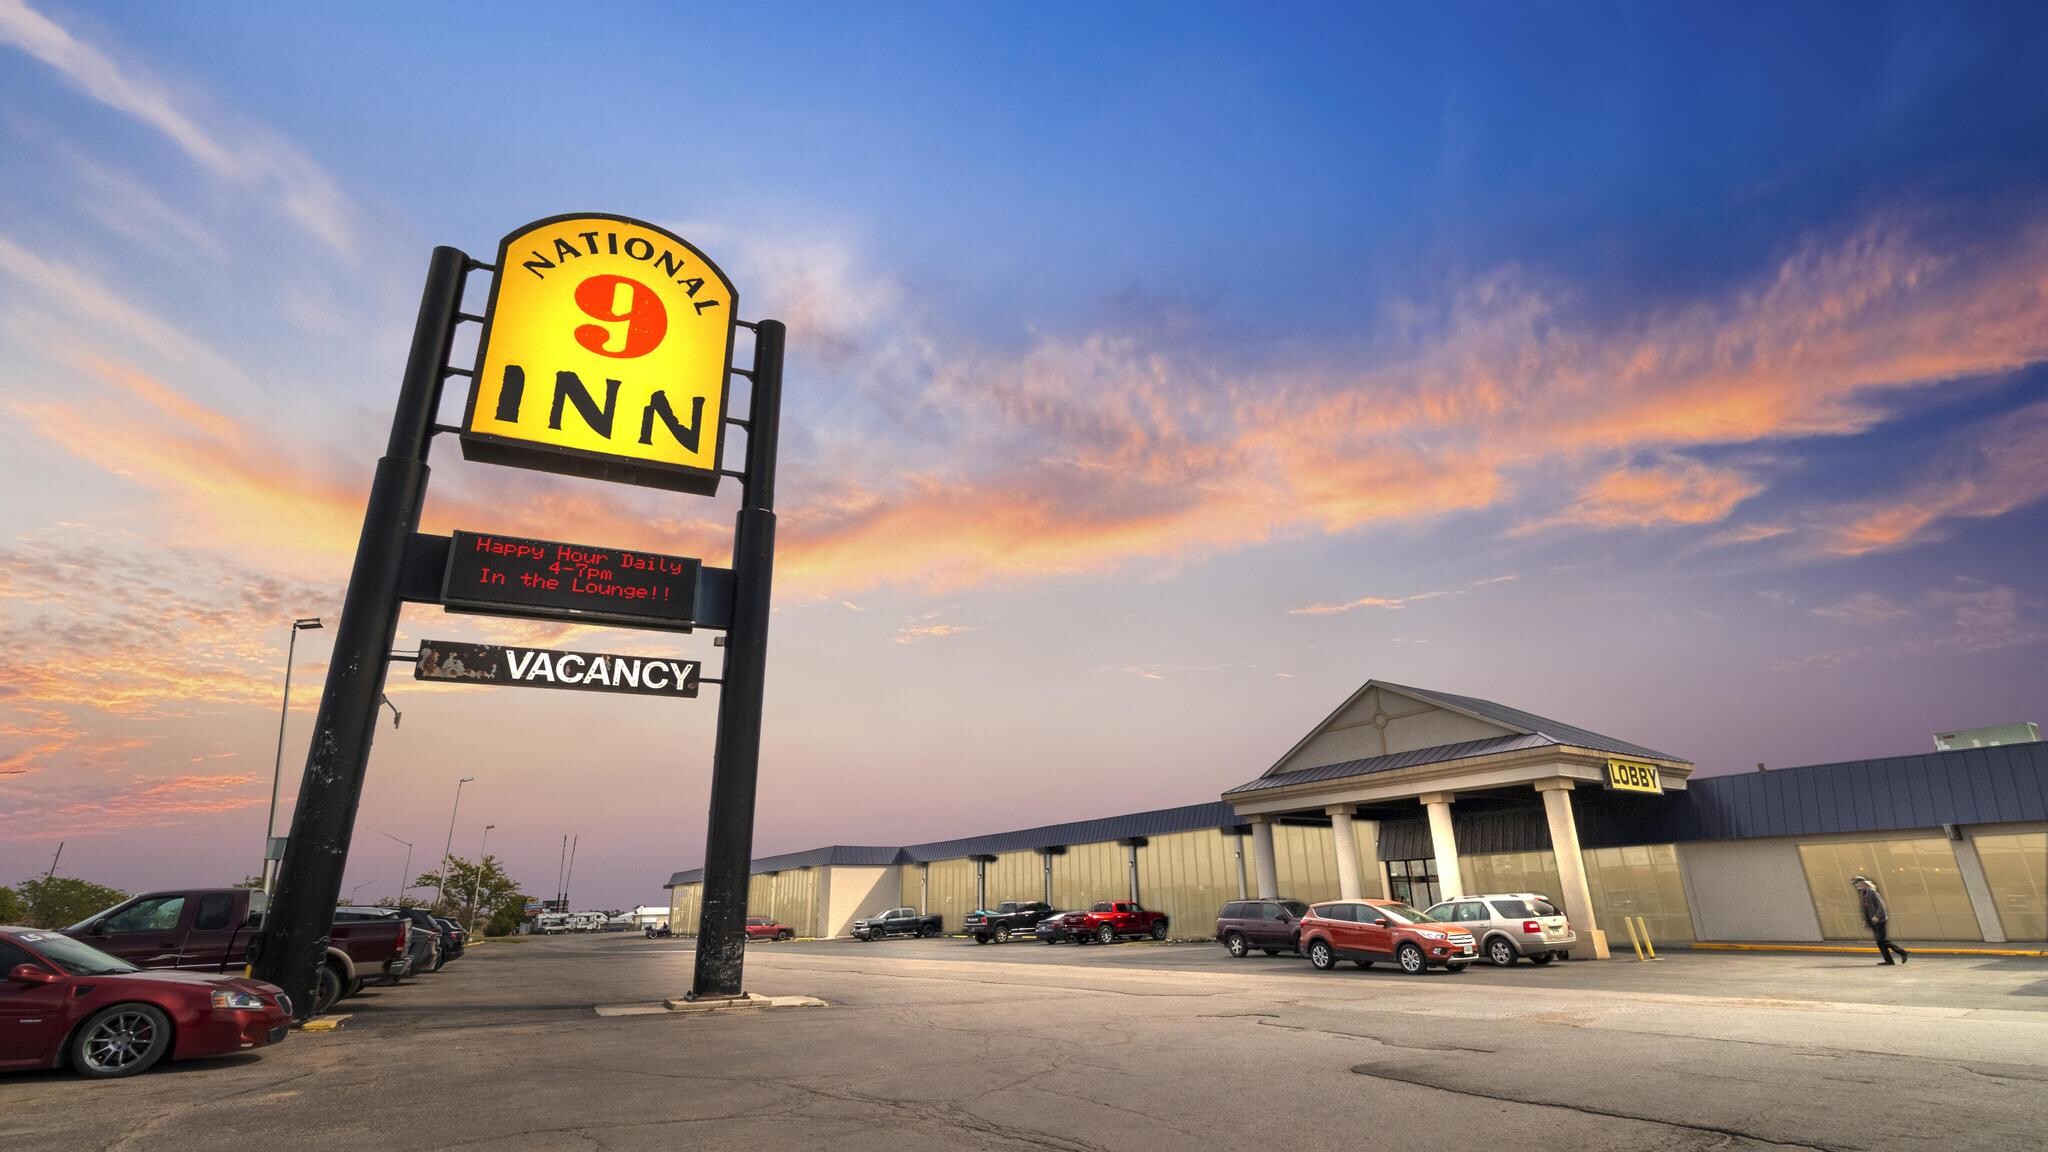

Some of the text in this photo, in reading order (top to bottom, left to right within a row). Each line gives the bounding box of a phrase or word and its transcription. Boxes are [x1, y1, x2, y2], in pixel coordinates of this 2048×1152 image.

[522, 231, 720, 316] NATIONAL
[574, 274, 668, 359] 9
[494, 364, 705, 454] INN
[476, 536, 682, 575] Happy Hour Daily
[548, 561, 613, 580] 4-7pm
[480, 568, 669, 601] In the Lounge!!
[505, 650, 694, 691] VACANCY
[1609, 763, 1657, 788] LOBBY
